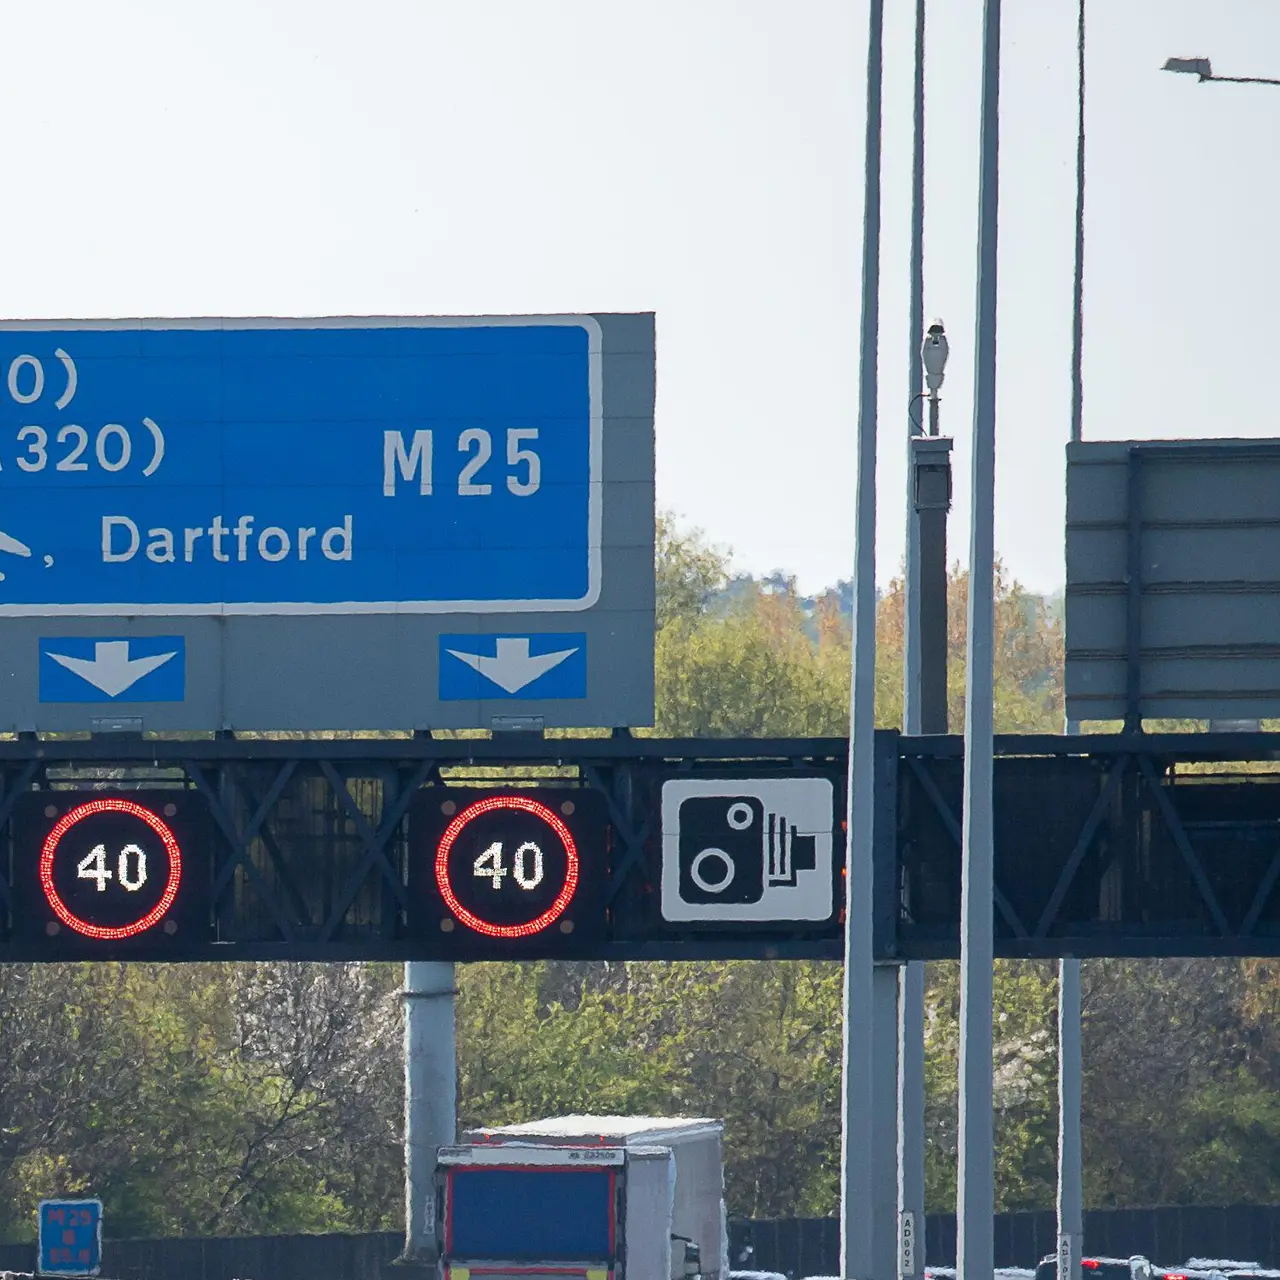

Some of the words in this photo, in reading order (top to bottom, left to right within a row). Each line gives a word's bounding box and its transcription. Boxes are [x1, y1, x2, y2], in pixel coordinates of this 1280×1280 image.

[102, 514, 353, 563] Dartford
[77, 845, 149, 892] 40
[473, 842, 544, 890] 40
